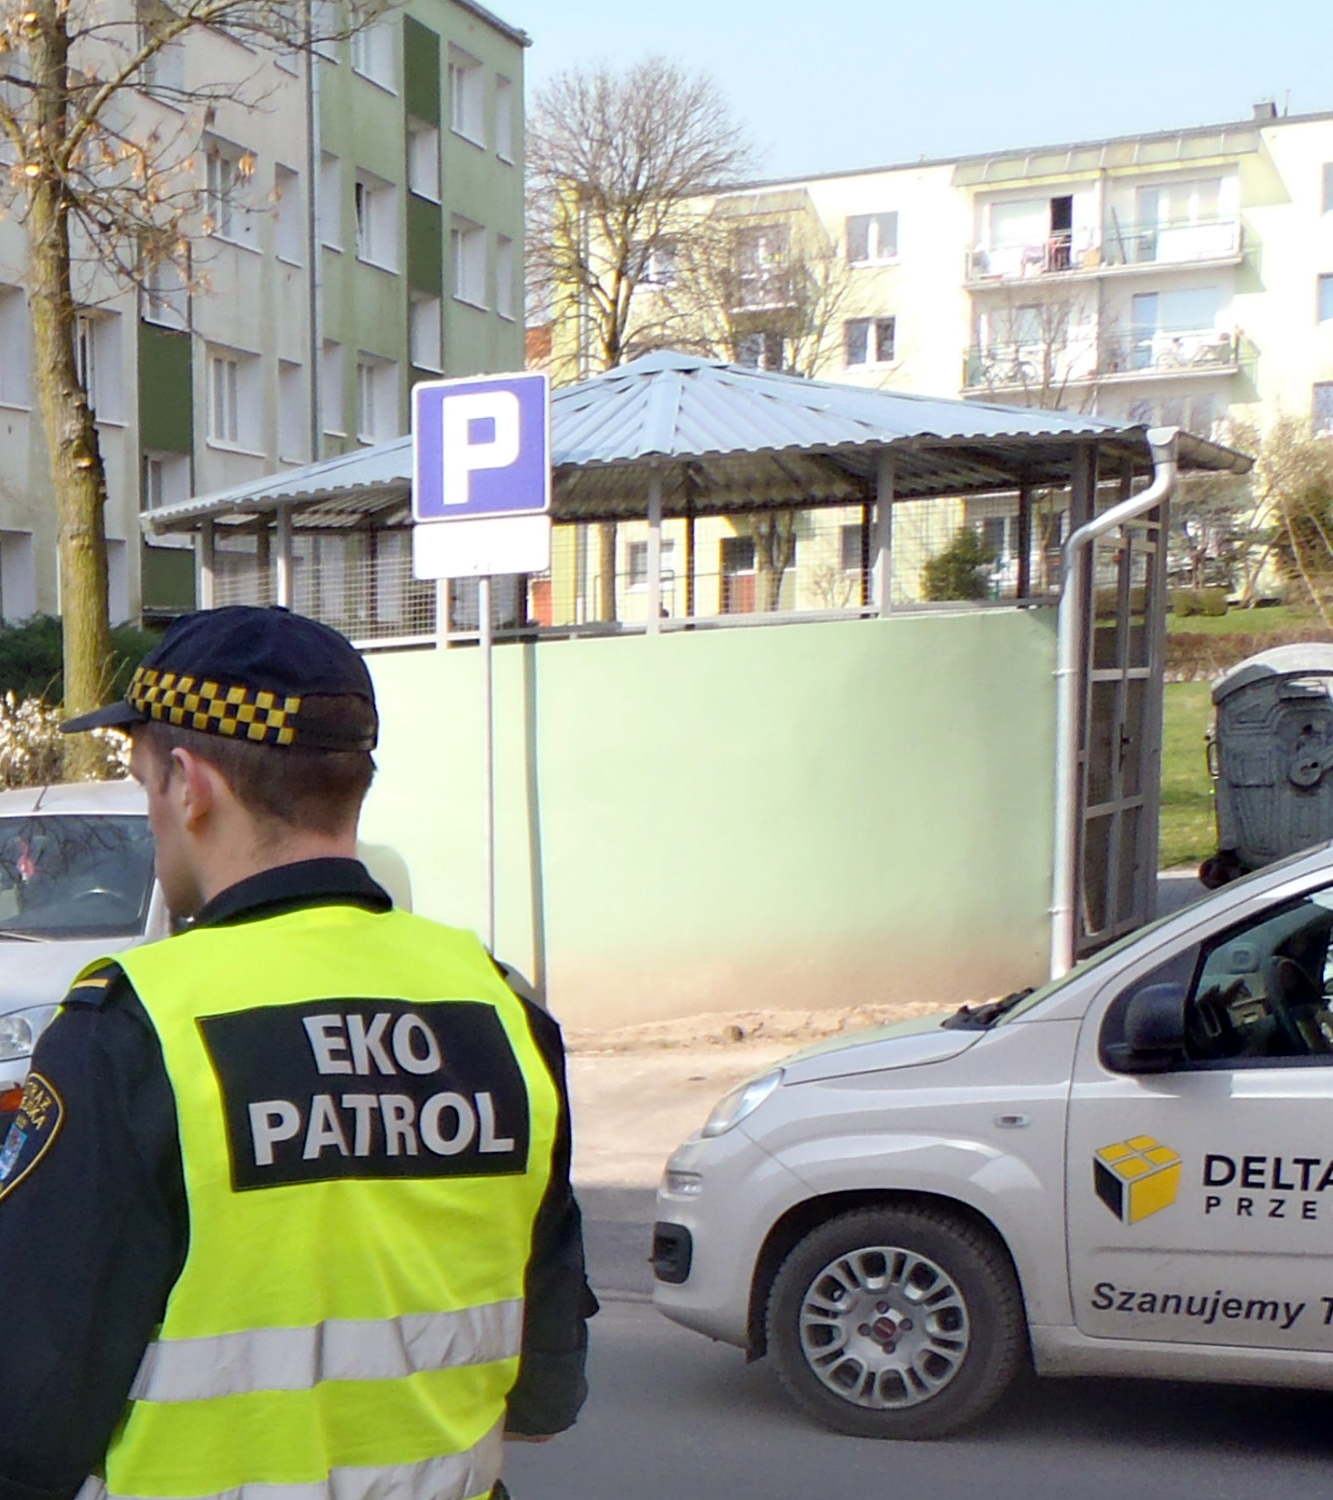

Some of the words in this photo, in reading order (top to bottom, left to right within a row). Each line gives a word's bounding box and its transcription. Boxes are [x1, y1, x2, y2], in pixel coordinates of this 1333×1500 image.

[443, 391, 520, 505] P
[302, 1013, 442, 1076] EKO
[248, 1091, 514, 1166] PATROL
[1205, 1196, 1318, 1220] PRZE
[1091, 1282, 1305, 1330] Szanujemy
[1319, 1296, 1333, 1325] T
